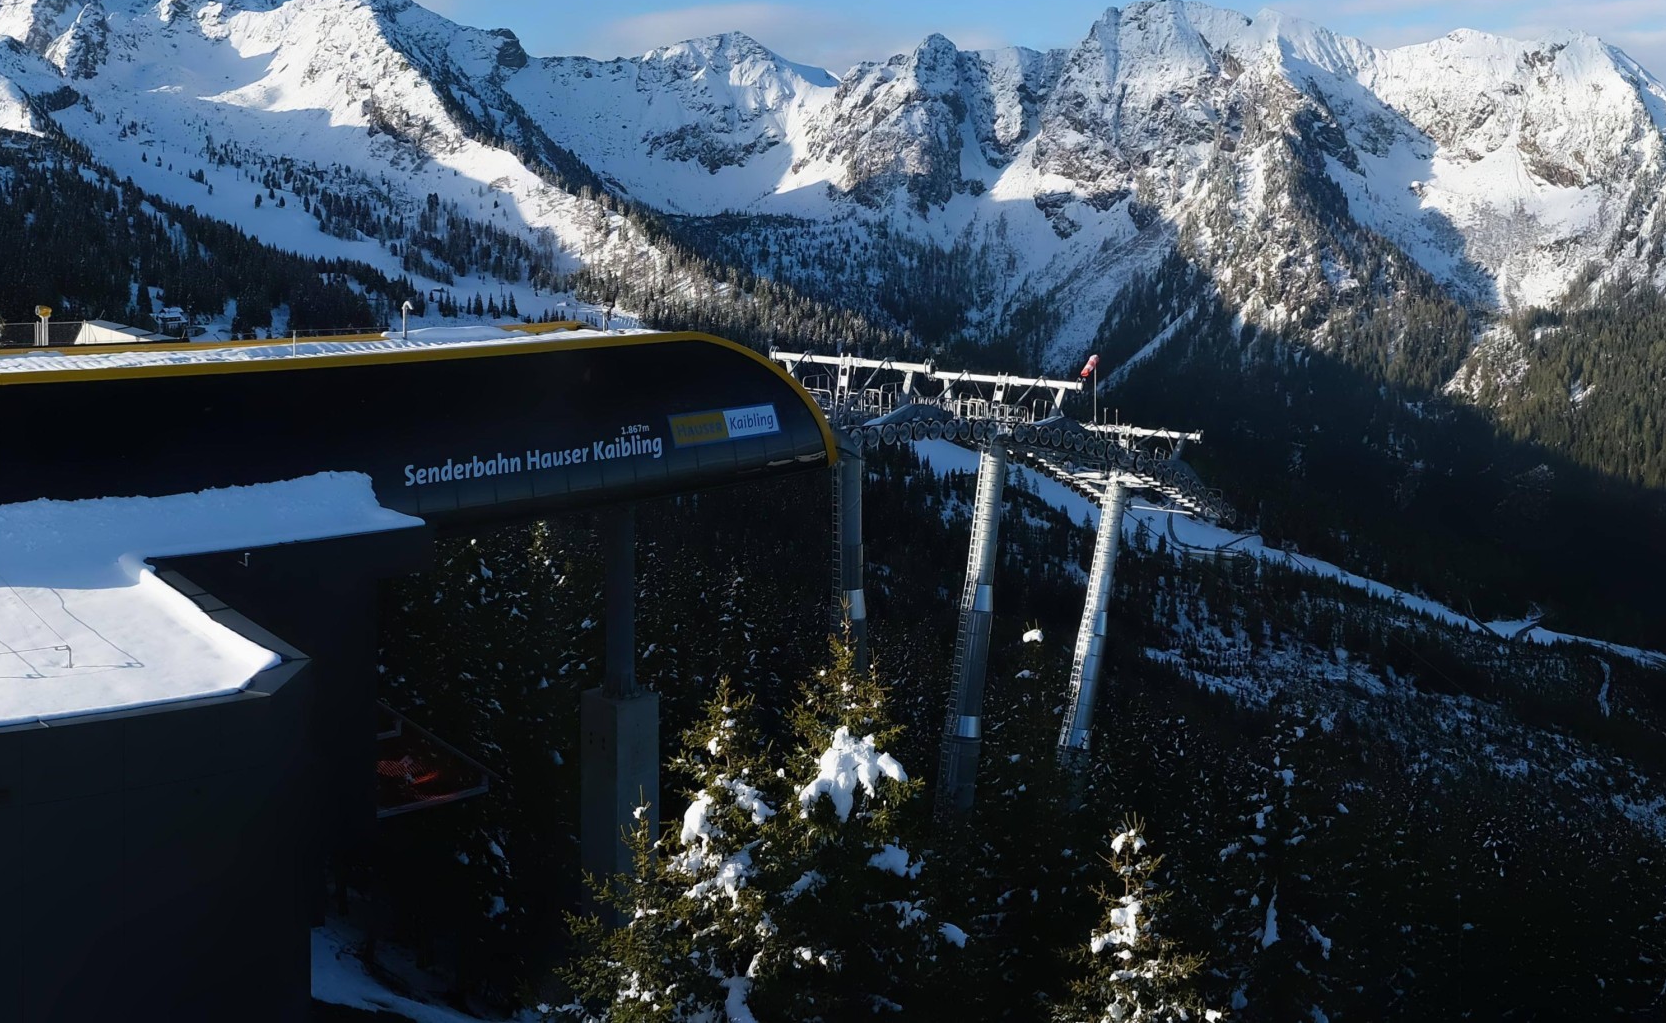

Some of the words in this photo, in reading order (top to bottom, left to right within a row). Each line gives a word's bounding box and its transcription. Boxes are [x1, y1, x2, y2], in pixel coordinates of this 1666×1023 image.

[621, 424, 650, 435] 1.867m
[729, 413, 774, 431] Kaibling
[404, 452, 521, 487] Senderbahn
[526, 448, 589, 470] Hauser
[593, 435, 663, 461] Kaibling
